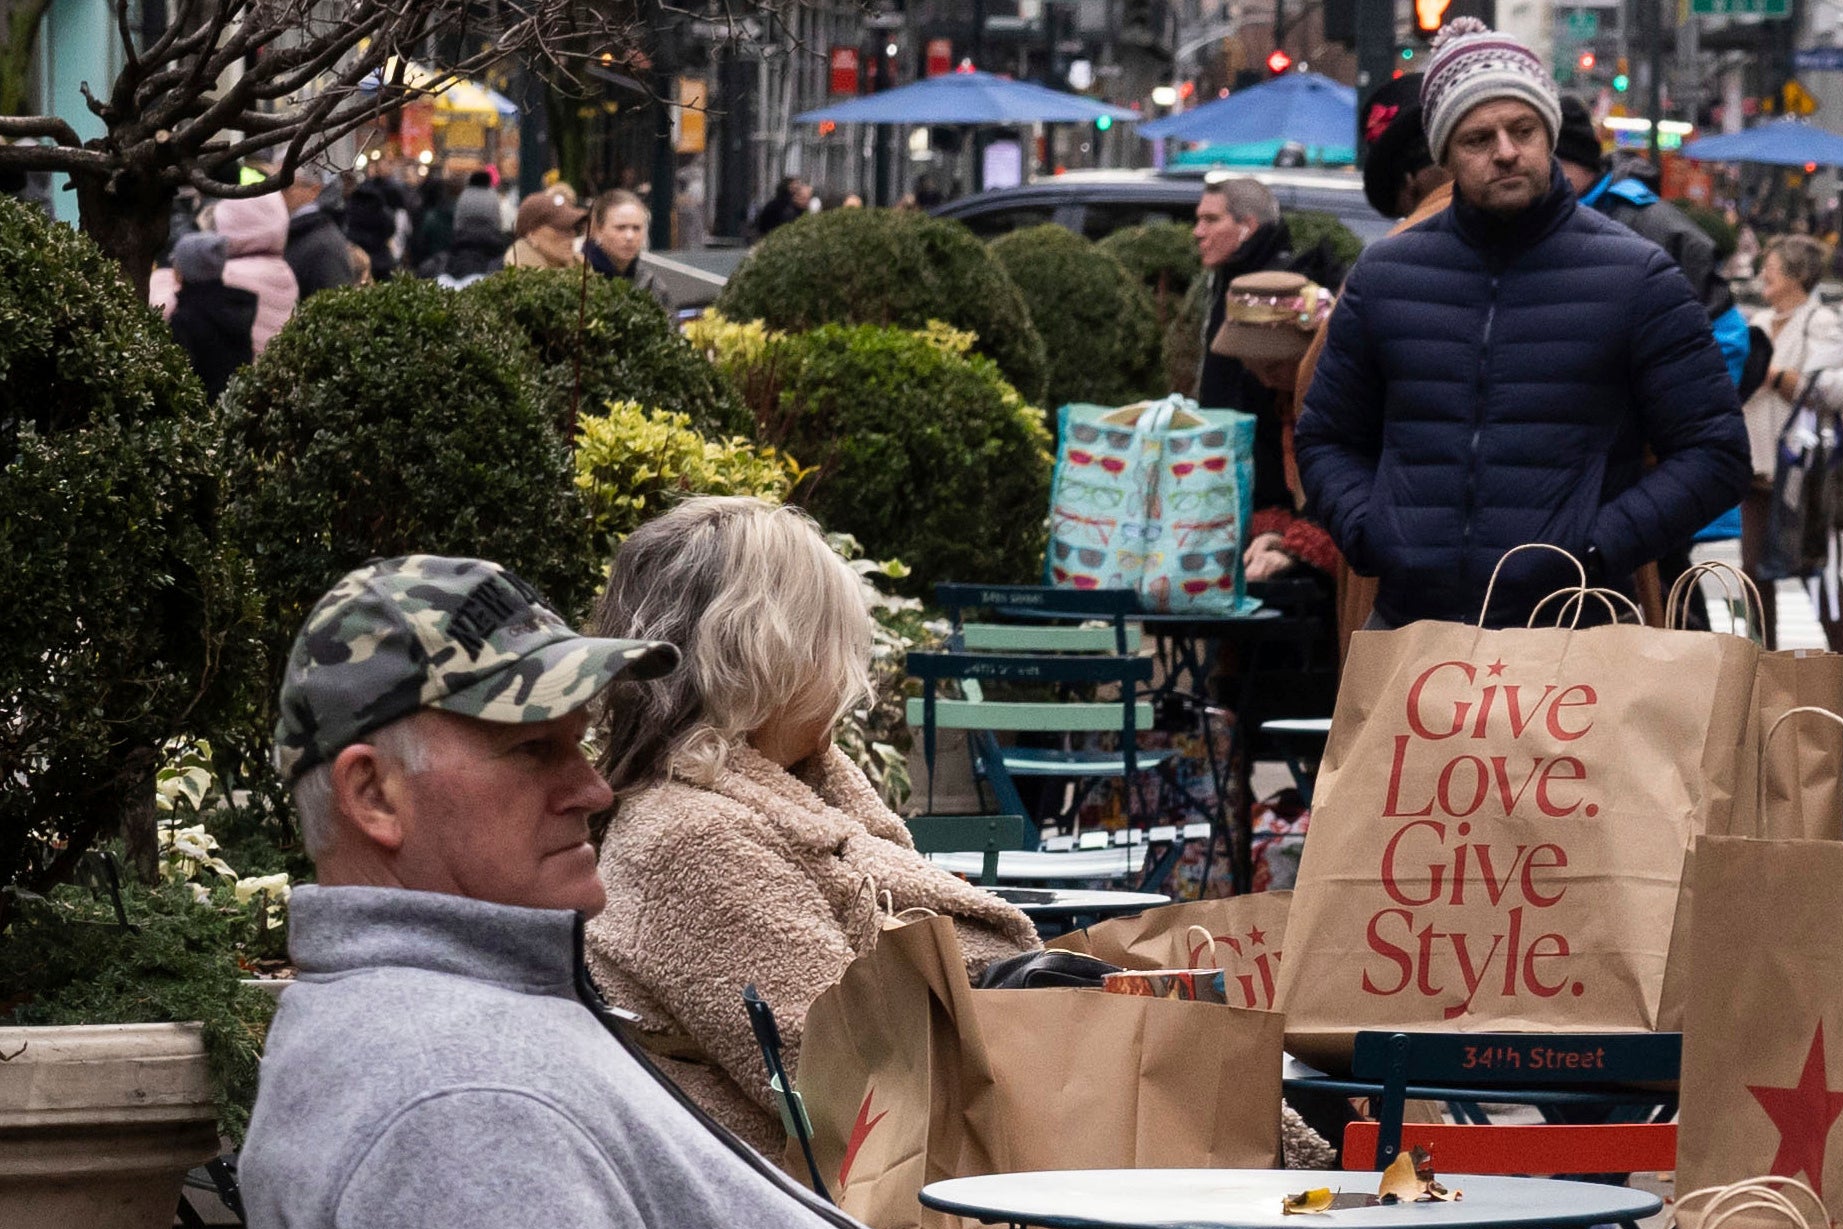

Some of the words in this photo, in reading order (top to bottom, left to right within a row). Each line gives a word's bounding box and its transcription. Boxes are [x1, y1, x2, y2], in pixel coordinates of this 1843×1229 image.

[1405, 658, 1598, 741] Give
[1381, 734, 1599, 818] Love.
[1381, 819, 1568, 908] Give
[1361, 906, 1585, 1020] Style.
[1462, 1046, 1521, 1069] 34th
[1529, 1046, 1606, 1070] Street
